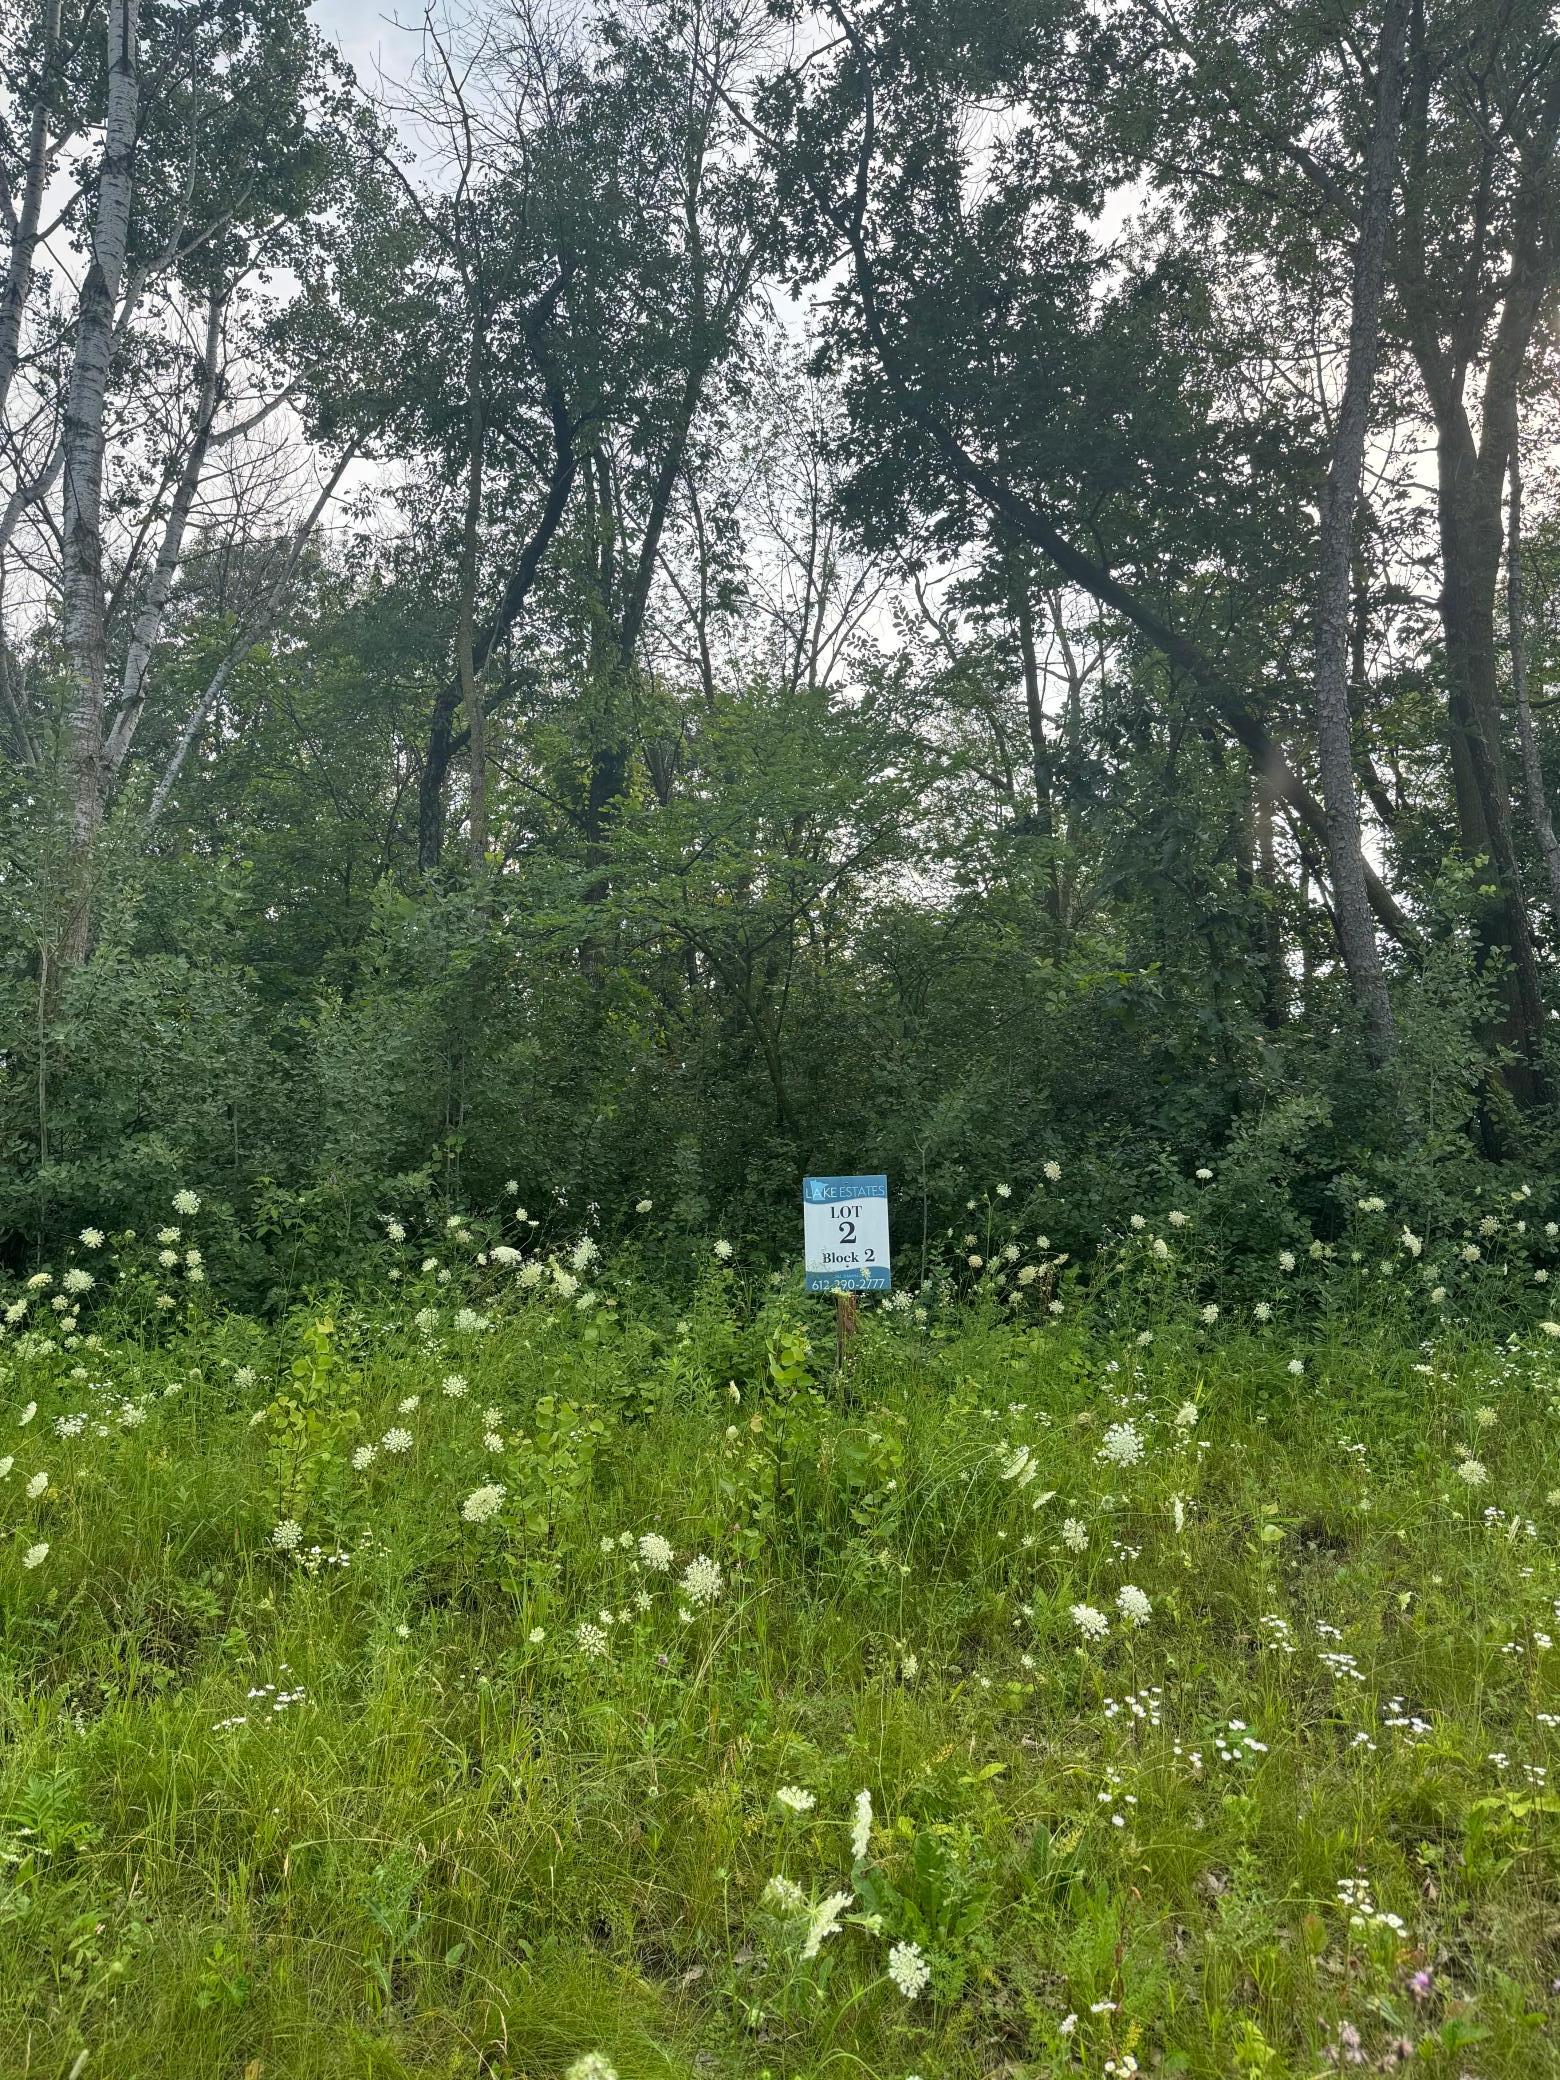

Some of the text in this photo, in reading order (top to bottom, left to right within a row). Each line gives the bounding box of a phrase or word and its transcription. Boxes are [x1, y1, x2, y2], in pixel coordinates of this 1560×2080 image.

[806, 1186, 885, 1199] LAKE ESTATES
[830, 1205, 862, 1218] LOT
[839, 1221, 857, 1244] 2
[823, 1248, 875, 1263] Block 2
